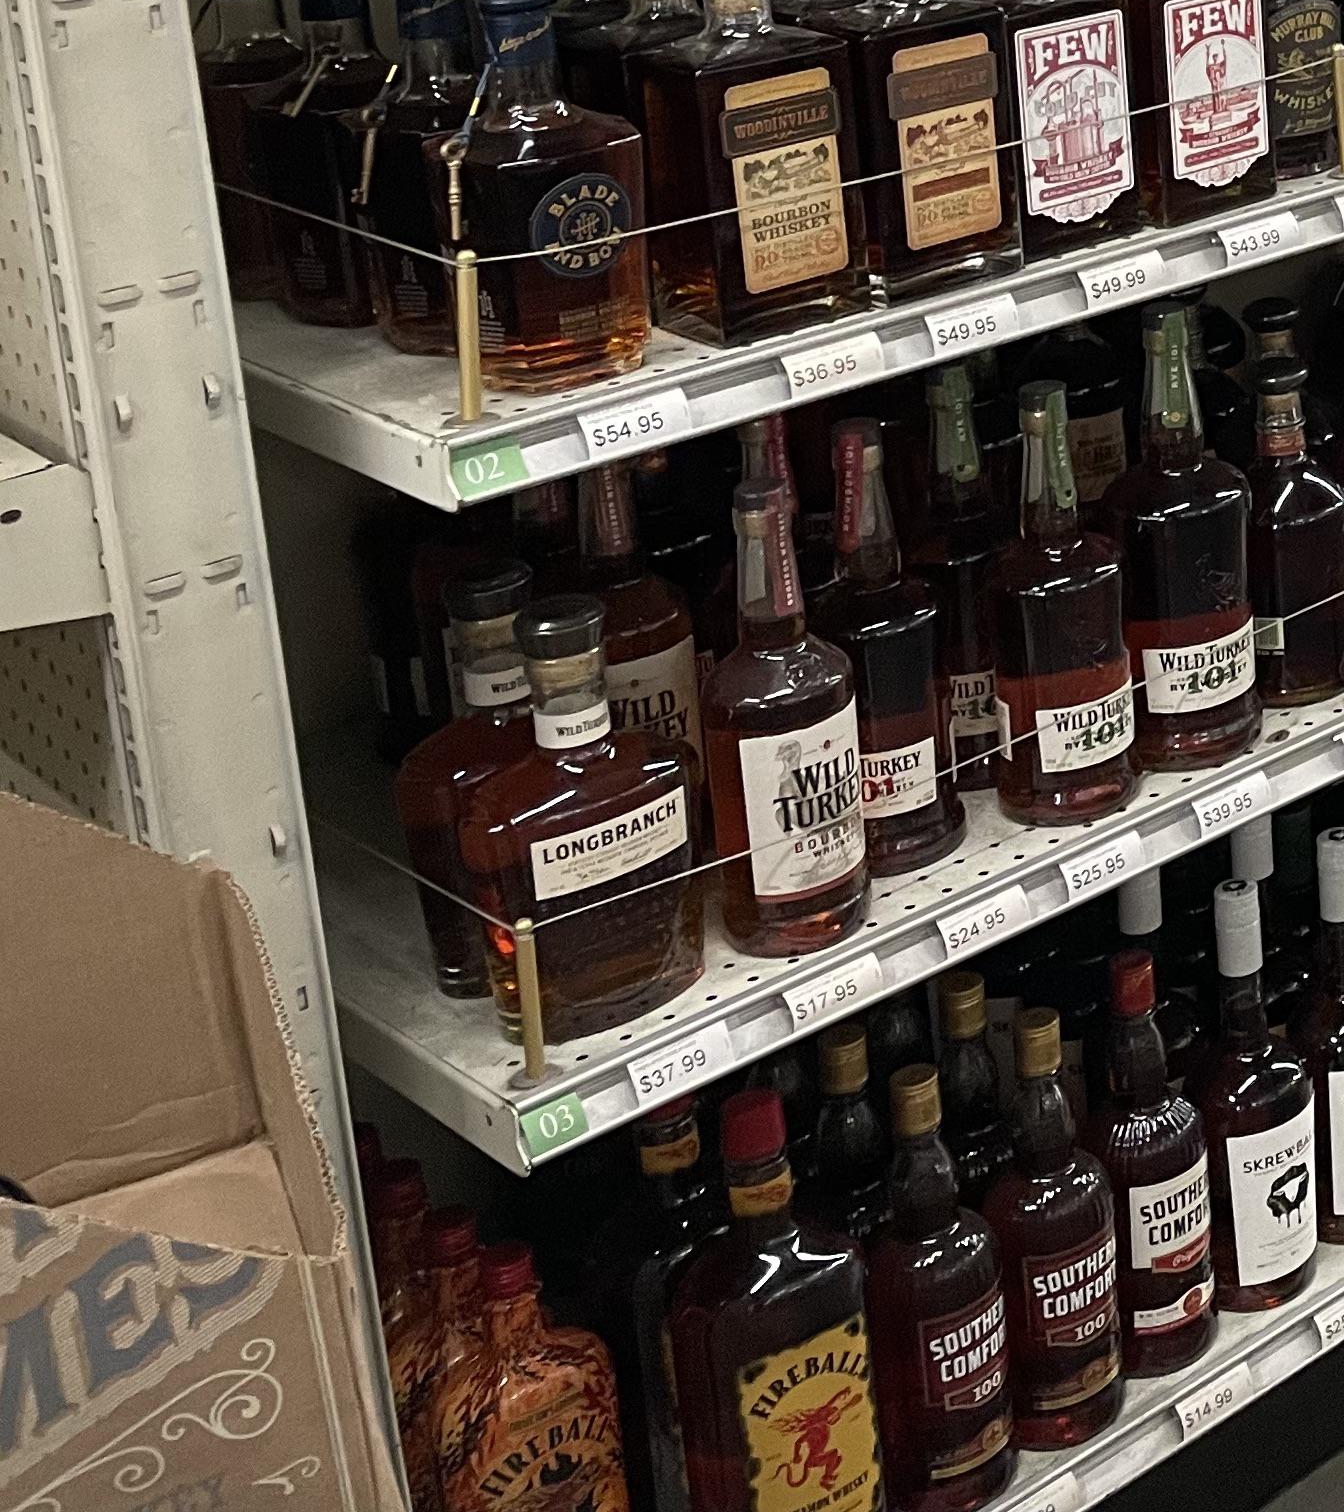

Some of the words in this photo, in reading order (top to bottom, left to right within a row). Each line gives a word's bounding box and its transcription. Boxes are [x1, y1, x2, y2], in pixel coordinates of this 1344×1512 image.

[1269, 11, 1320, 42] MURRAY
[1294, 25, 1324, 44] CLUB
[1030, 23, 1110, 81] FEW
[1273, 87, 1334, 109] WHISKE
[733, 102, 829, 140] WOODINVILLE
[548, 183, 620, 219] BLADE
[751, 198, 832, 231] BOURBON
[752, 212, 832, 245] WHISKEY
[1229, 228, 1282, 258] $43.99
[1090, 269, 1147, 300] $49.99
[936, 315, 998, 348] $49.95
[1169, 343, 1179, 361] 101
[792, 354, 859, 389] $36.95
[1169, 365, 1180, 390] RYE
[592, 411, 666, 449] $54.95
[464, 451, 507, 486] 02
[1158, 650, 1206, 675] WILD
[555, 723, 583, 738] WILD
[1052, 706, 1099, 733] WILD
[792, 746, 857, 795] WILD
[1202, 792, 1254, 829] $39.95
[541, 797, 678, 866] LONGBRANCH
[1070, 853, 1127, 891] $25.95
[948, 908, 1007, 950] $24.95
[794, 977, 859, 1021] $17.95
[639, 1048, 708, 1094] $37.99
[538, 1104, 577, 1140] 03
[1074, 1313, 1107, 1343] 100
[749, 1350, 870, 1420] FIREBALL
[972, 1370, 1002, 1404] 100
[1183, 1387, 1235, 1429] $14.99
